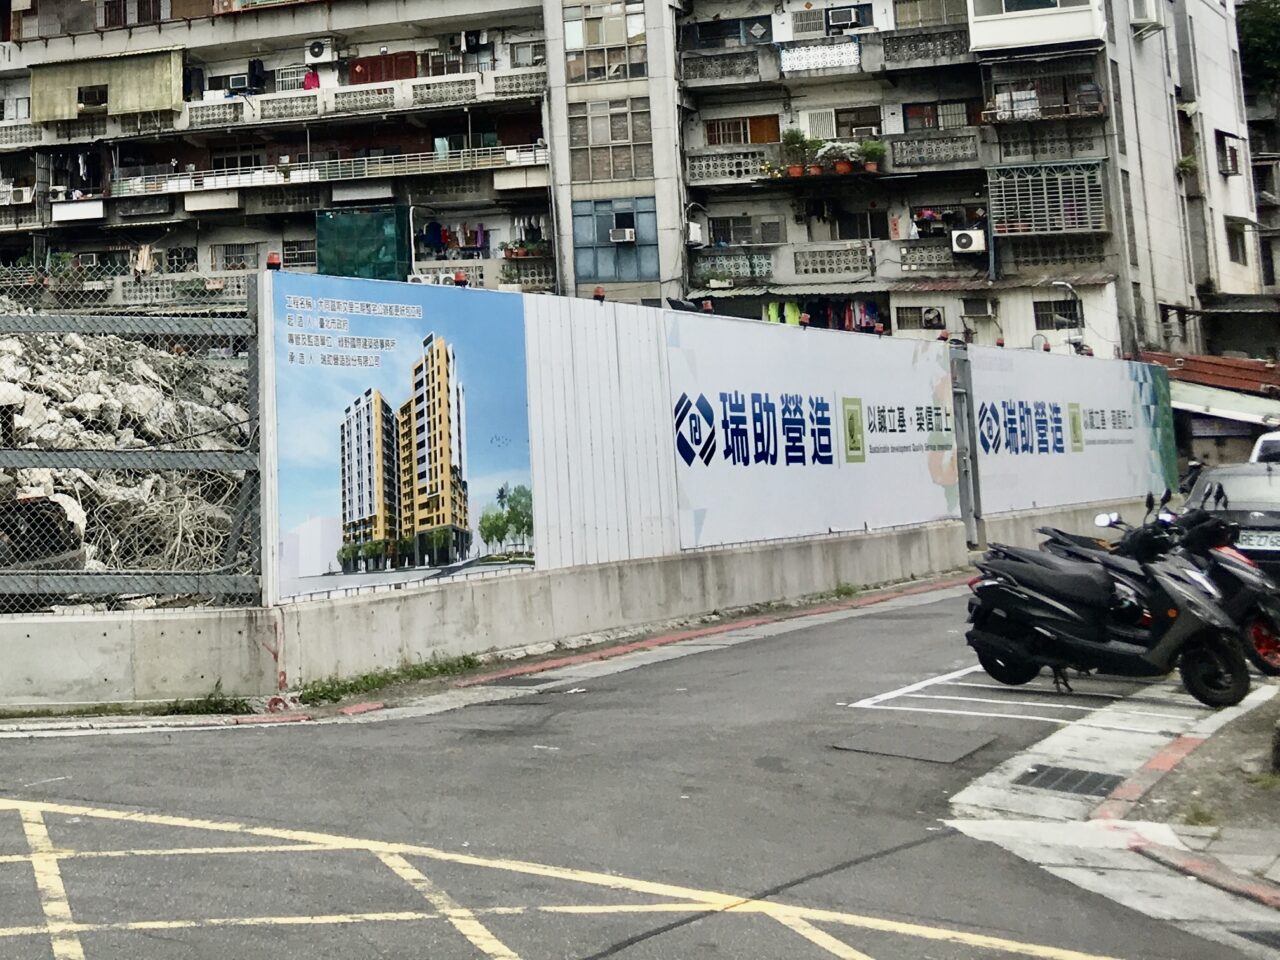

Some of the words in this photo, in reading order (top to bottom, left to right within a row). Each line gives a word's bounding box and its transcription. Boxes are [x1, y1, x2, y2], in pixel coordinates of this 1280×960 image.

[719, 390, 833, 467] 瑞助營造
[1002, 399, 1064, 455] 瑞助營造
